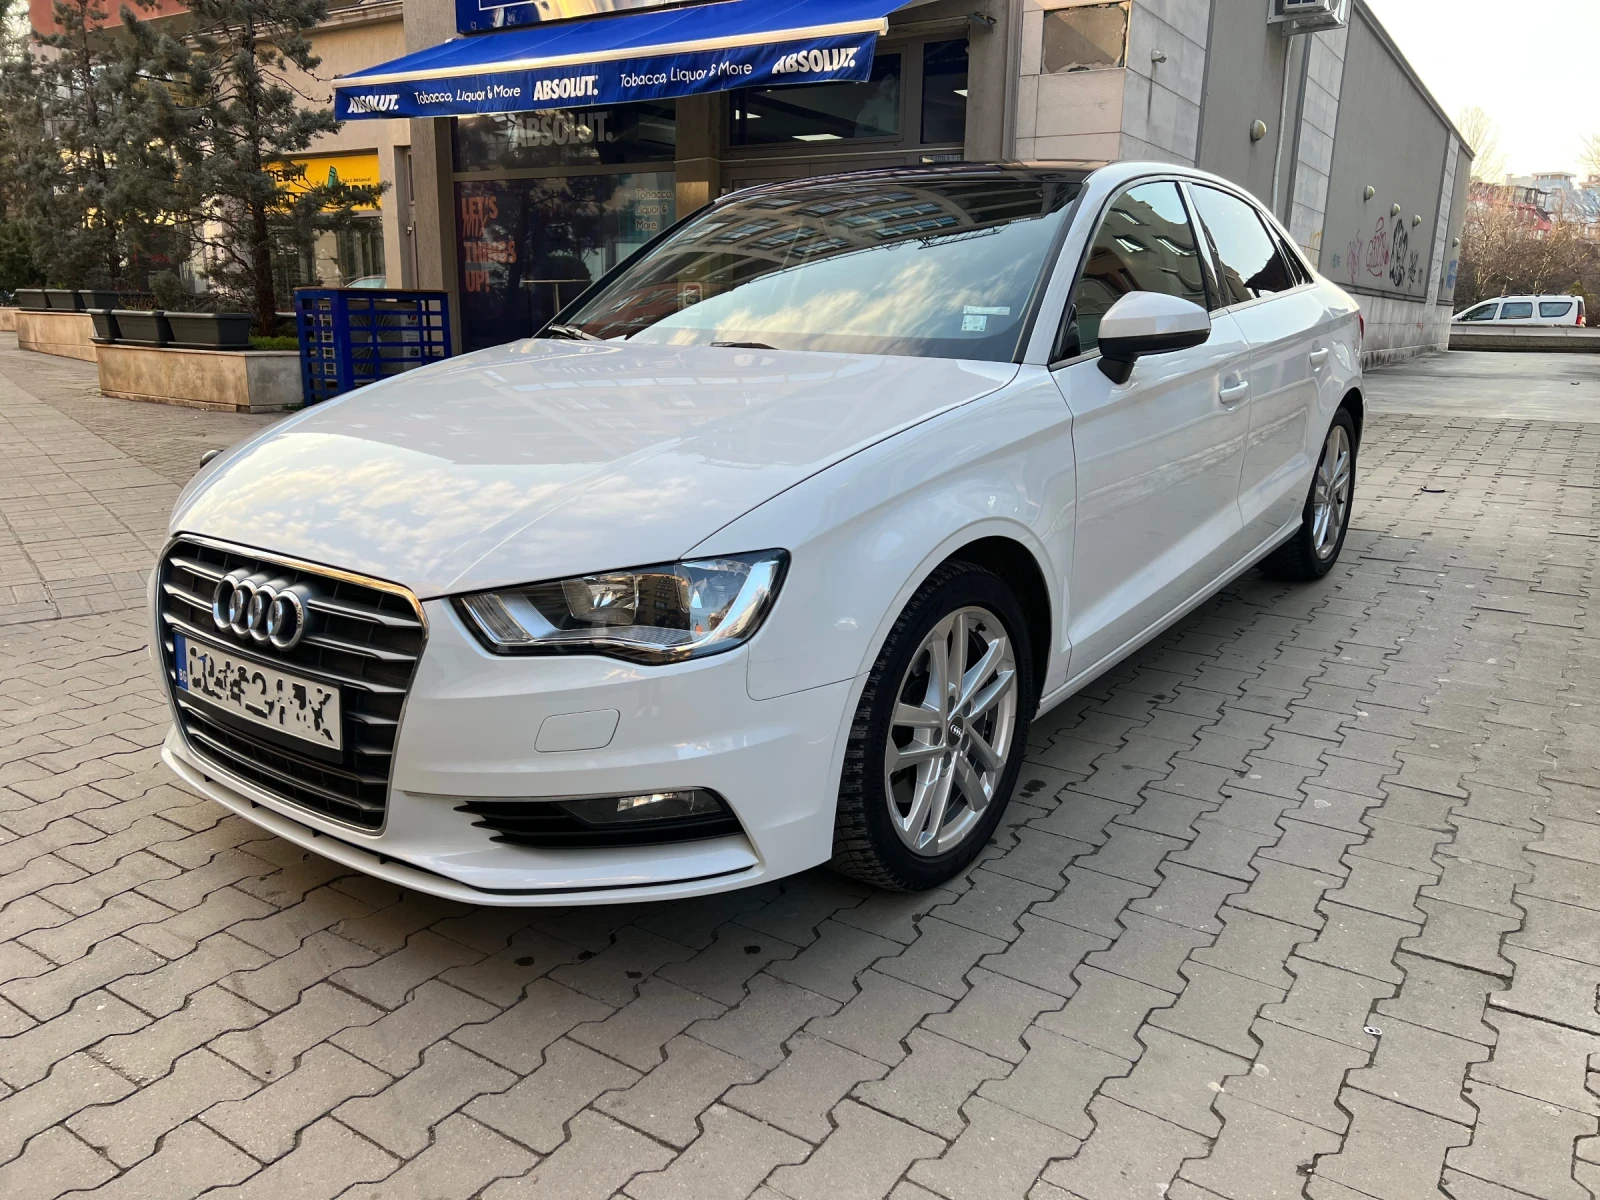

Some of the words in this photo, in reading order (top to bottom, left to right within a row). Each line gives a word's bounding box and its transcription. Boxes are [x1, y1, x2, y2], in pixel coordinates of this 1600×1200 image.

[456, 89, 485, 101] Liquor
[487, 86, 492, 99] &
[494, 84, 521, 98] More
[533, 75, 598, 101] ABSOLUT.
[620, 73, 667, 88] Tobacco,
[671, 66, 707, 82] Liquor
[709, 64, 716, 77] &
[718, 60, 752, 76] More
[636, 189, 674, 200] Tobacco,
[461, 196, 498, 219] LET'S
[636, 204, 659, 216] Liquor
[661, 203, 668, 214] &
[463, 214, 488, 237] MIX
[636, 220, 657, 231] More
[465, 270, 490, 292] UP!
